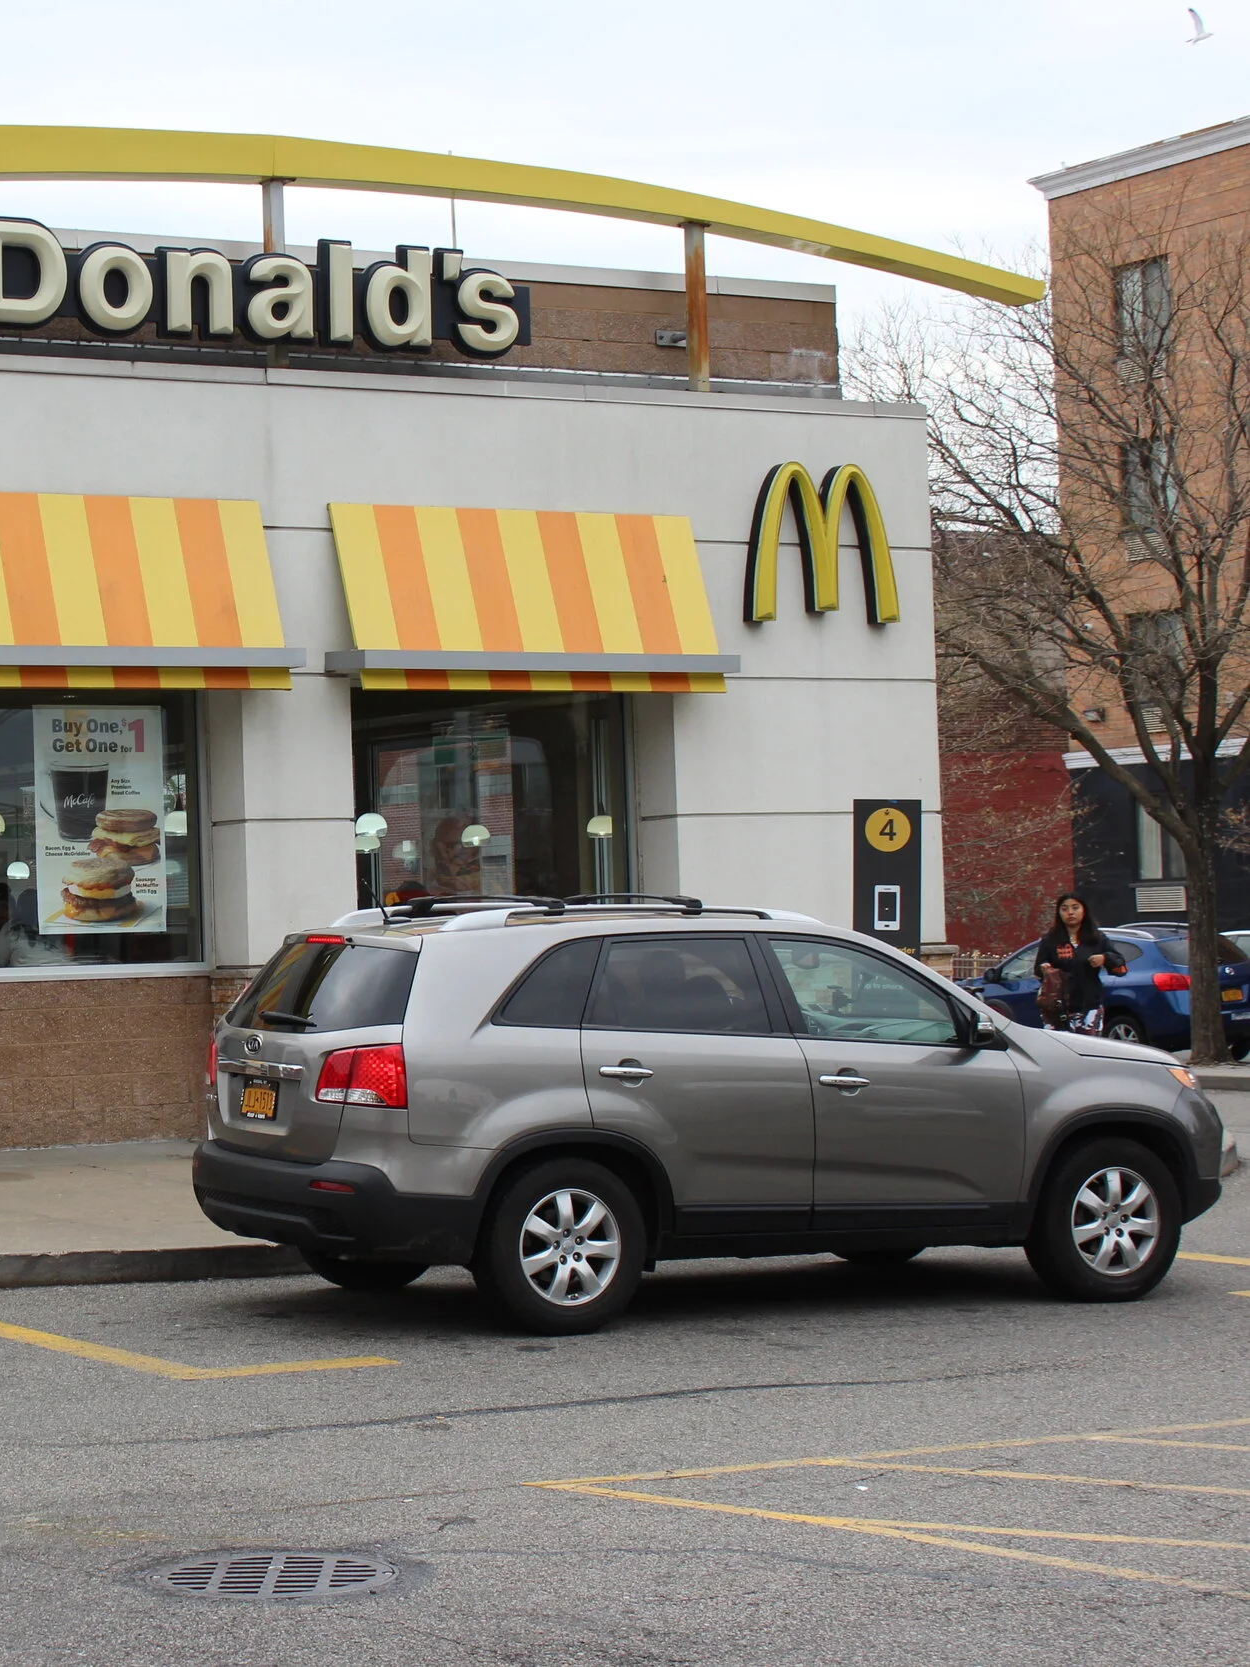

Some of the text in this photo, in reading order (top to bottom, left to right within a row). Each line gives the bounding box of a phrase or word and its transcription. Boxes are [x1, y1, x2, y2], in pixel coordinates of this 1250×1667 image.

[52, 718, 123, 737] Buy One,
[52, 738, 82, 752] Get
[86, 738, 118, 752] One
[879, 818, 897, 841] 4
